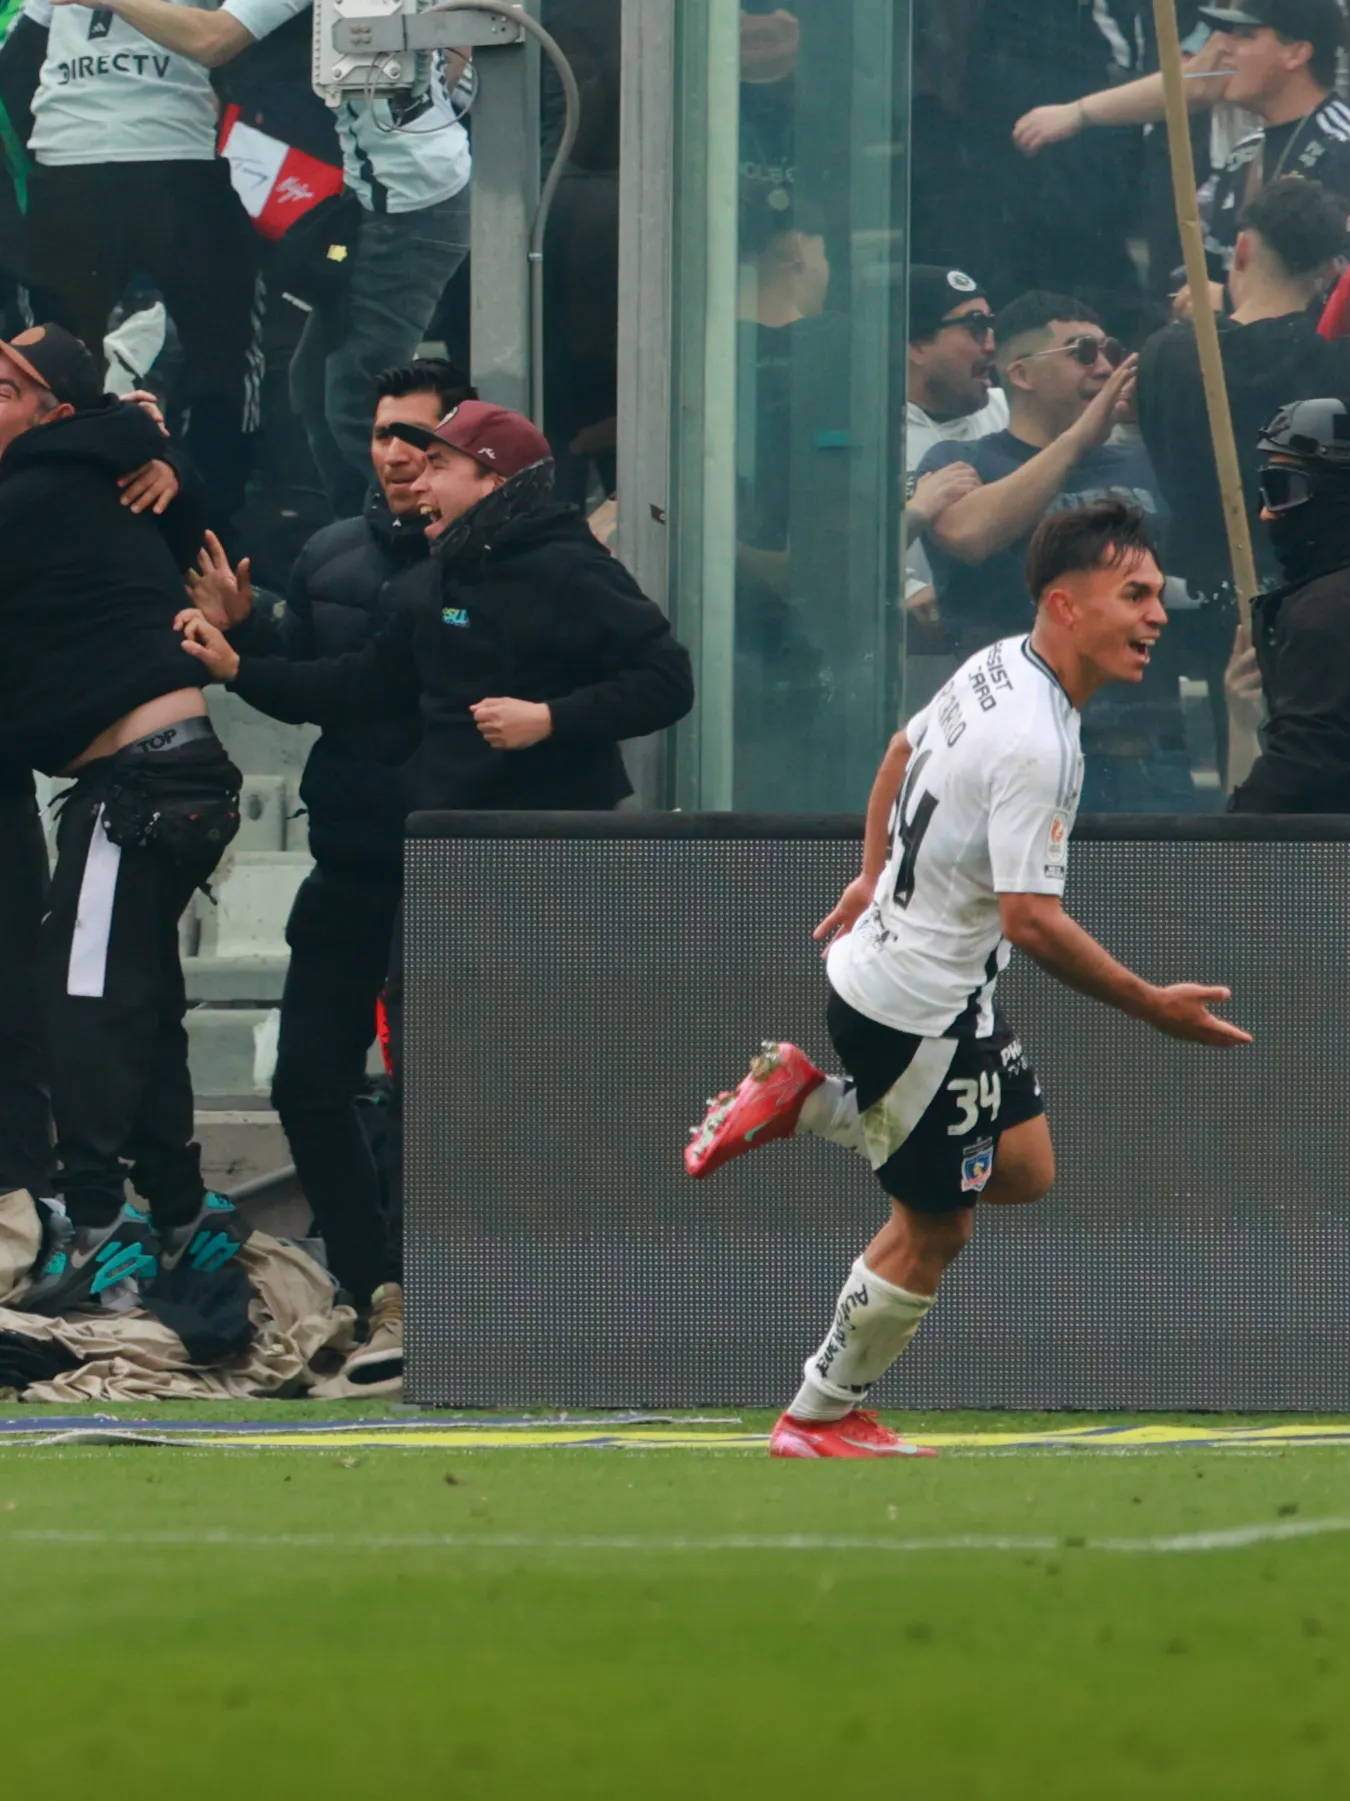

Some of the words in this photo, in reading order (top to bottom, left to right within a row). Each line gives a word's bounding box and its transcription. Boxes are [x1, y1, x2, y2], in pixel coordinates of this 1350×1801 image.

[57, 54, 170, 85] DIRECTV
[136, 728, 177, 753] TOP
[888, 749, 940, 911] 4
[946, 1070, 1002, 1136] 34
